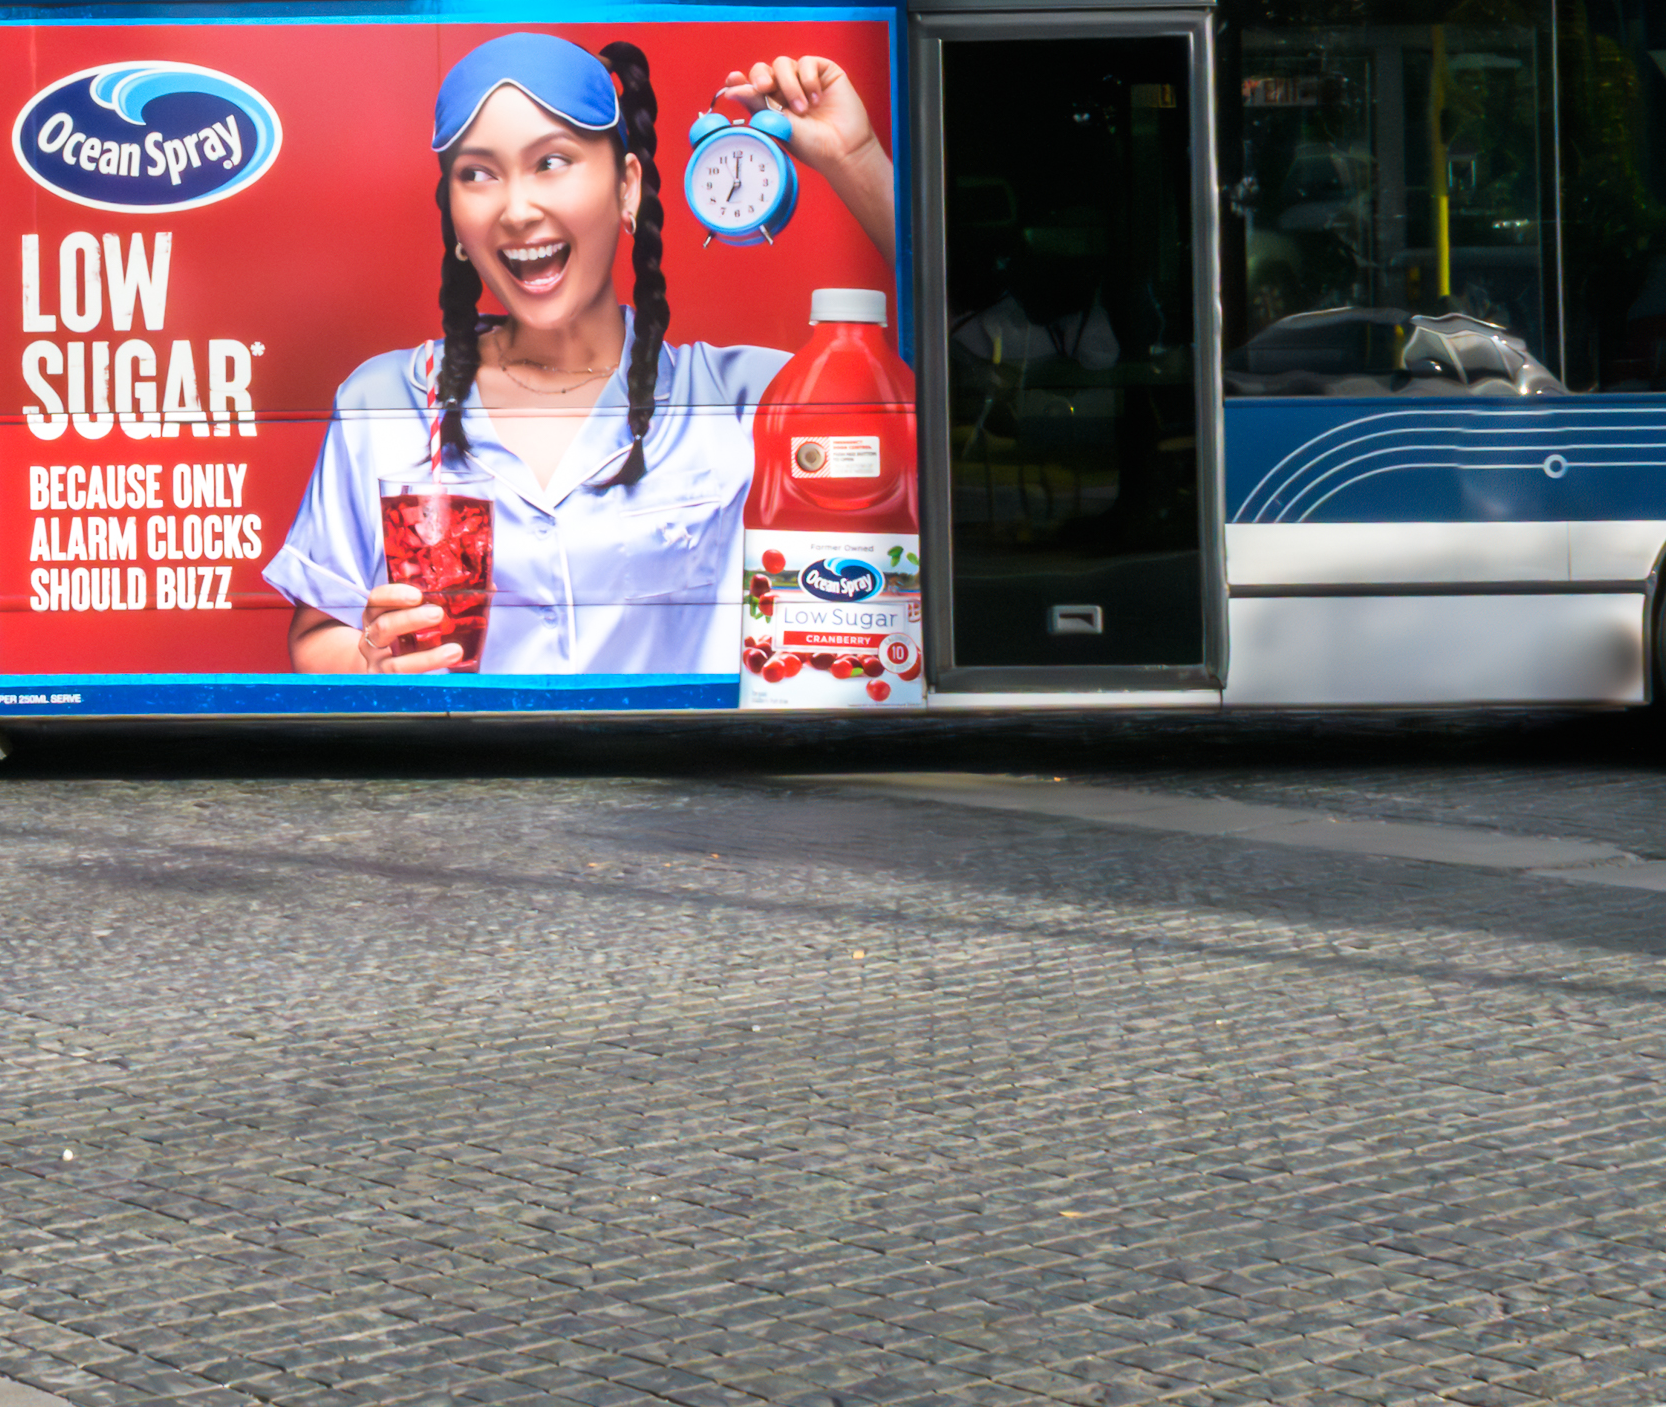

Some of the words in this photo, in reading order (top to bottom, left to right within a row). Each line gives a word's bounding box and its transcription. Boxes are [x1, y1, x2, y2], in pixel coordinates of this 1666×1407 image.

[38, 112, 141, 177] Ocean
[144, 114, 243, 185] Spray
[22, 232, 172, 332] LOW
[30, 464, 163, 510] BECAUSE
[172, 463, 247, 508] ONLY
[30, 516, 137, 562] ALARM
[146, 514, 262, 560] CLOCKS
[844, 544, 874, 553] Owned
[30, 567, 146, 612] SHOULD
[156, 566, 233, 610] BUZZ
[806, 570, 839, 594] Ocean
[840, 574, 873, 597] Spray
[784, 607, 828, 625] Low
[832, 608, 898, 630] Sugar
[806, 634, 871, 645] CRANBERRY
[892, 645, 904, 660] 10
[50, 694, 82, 704] SERVE
